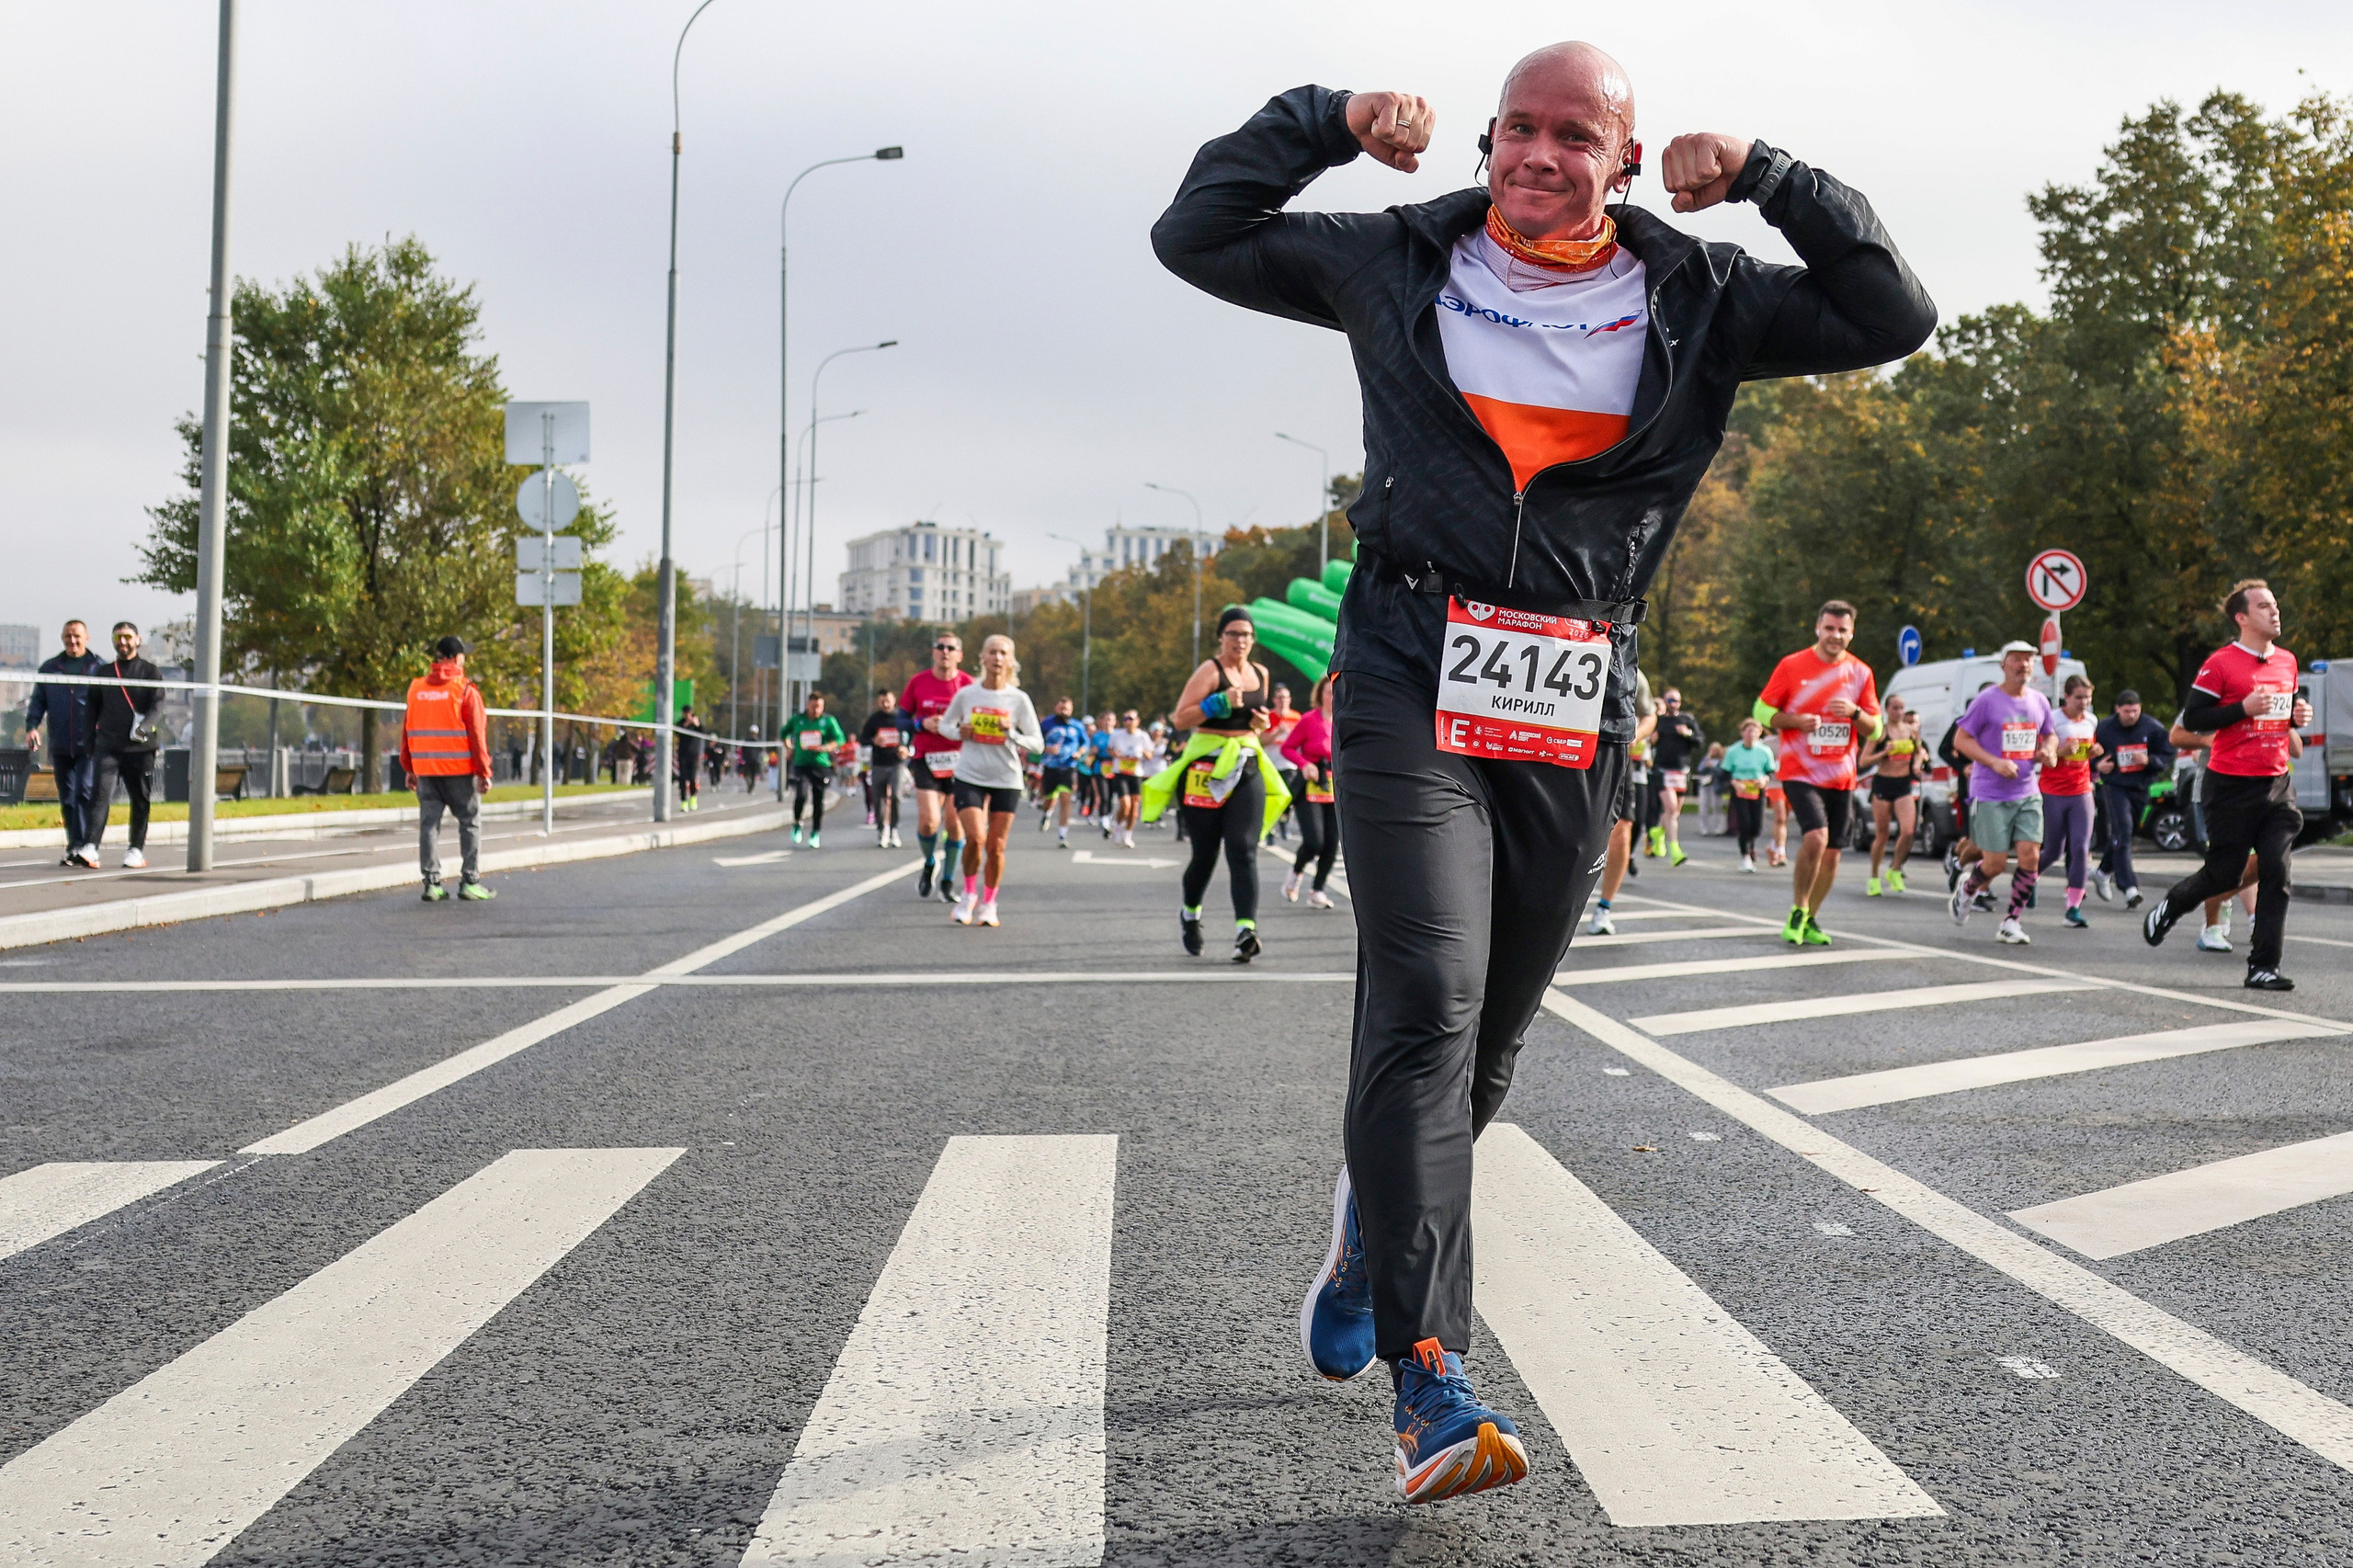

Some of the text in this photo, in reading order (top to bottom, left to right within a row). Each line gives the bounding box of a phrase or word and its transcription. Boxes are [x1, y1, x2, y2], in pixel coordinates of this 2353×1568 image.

[1497, 618, 1542, 631] МАРАФОН
[1498, 609, 1558, 625] МОСКОВСКИЙ
[1448, 634, 1602, 700] 24143
[1491, 695, 1555, 717] КИРИЛЛ
[1450, 719, 1470, 747] E
